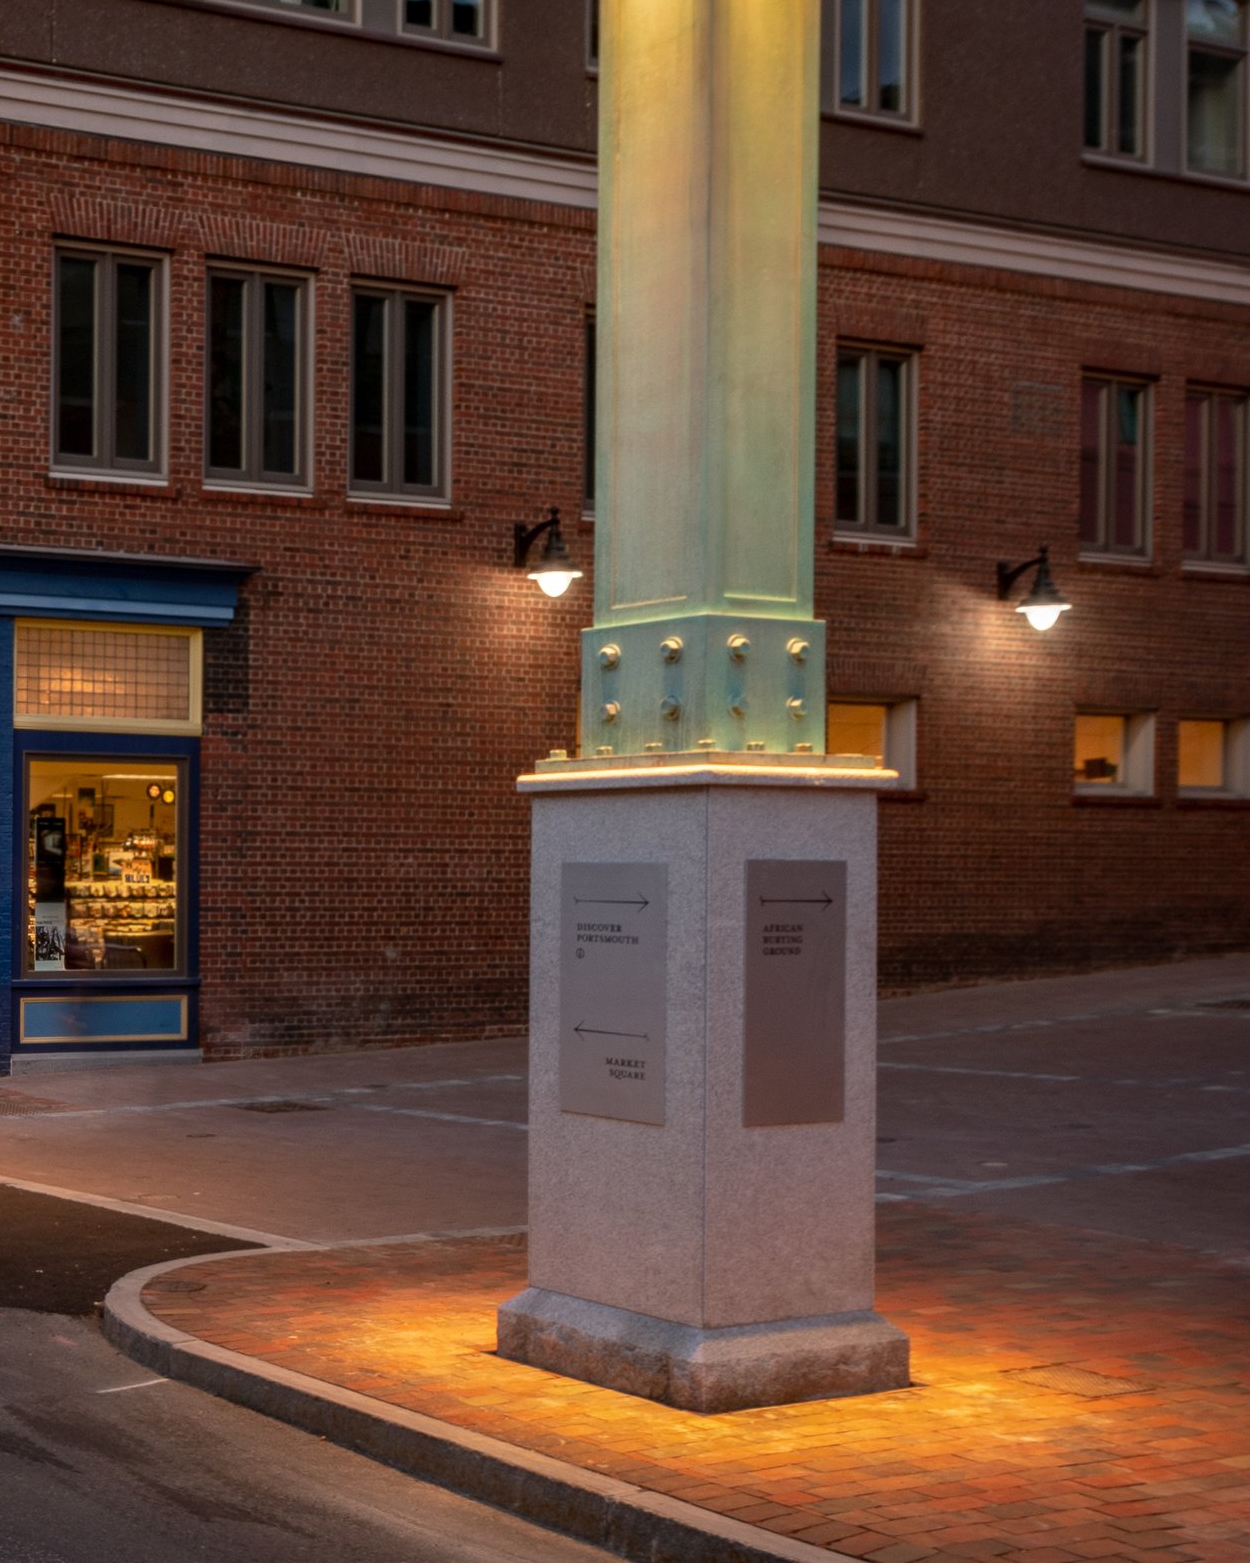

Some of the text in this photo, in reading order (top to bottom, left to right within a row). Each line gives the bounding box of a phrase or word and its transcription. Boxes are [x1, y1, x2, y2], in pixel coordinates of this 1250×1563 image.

[577, 923, 622, 933] DISCOVER
[763, 924, 803, 933] AFRICAN
[577, 934, 639, 945] PORTSMOUTH
[763, 935, 804, 944] BURYING
[762, 947, 802, 956] GROUND
[606, 1057, 647, 1069] MARKET
[609, 1068, 647, 1081] SQUARE
